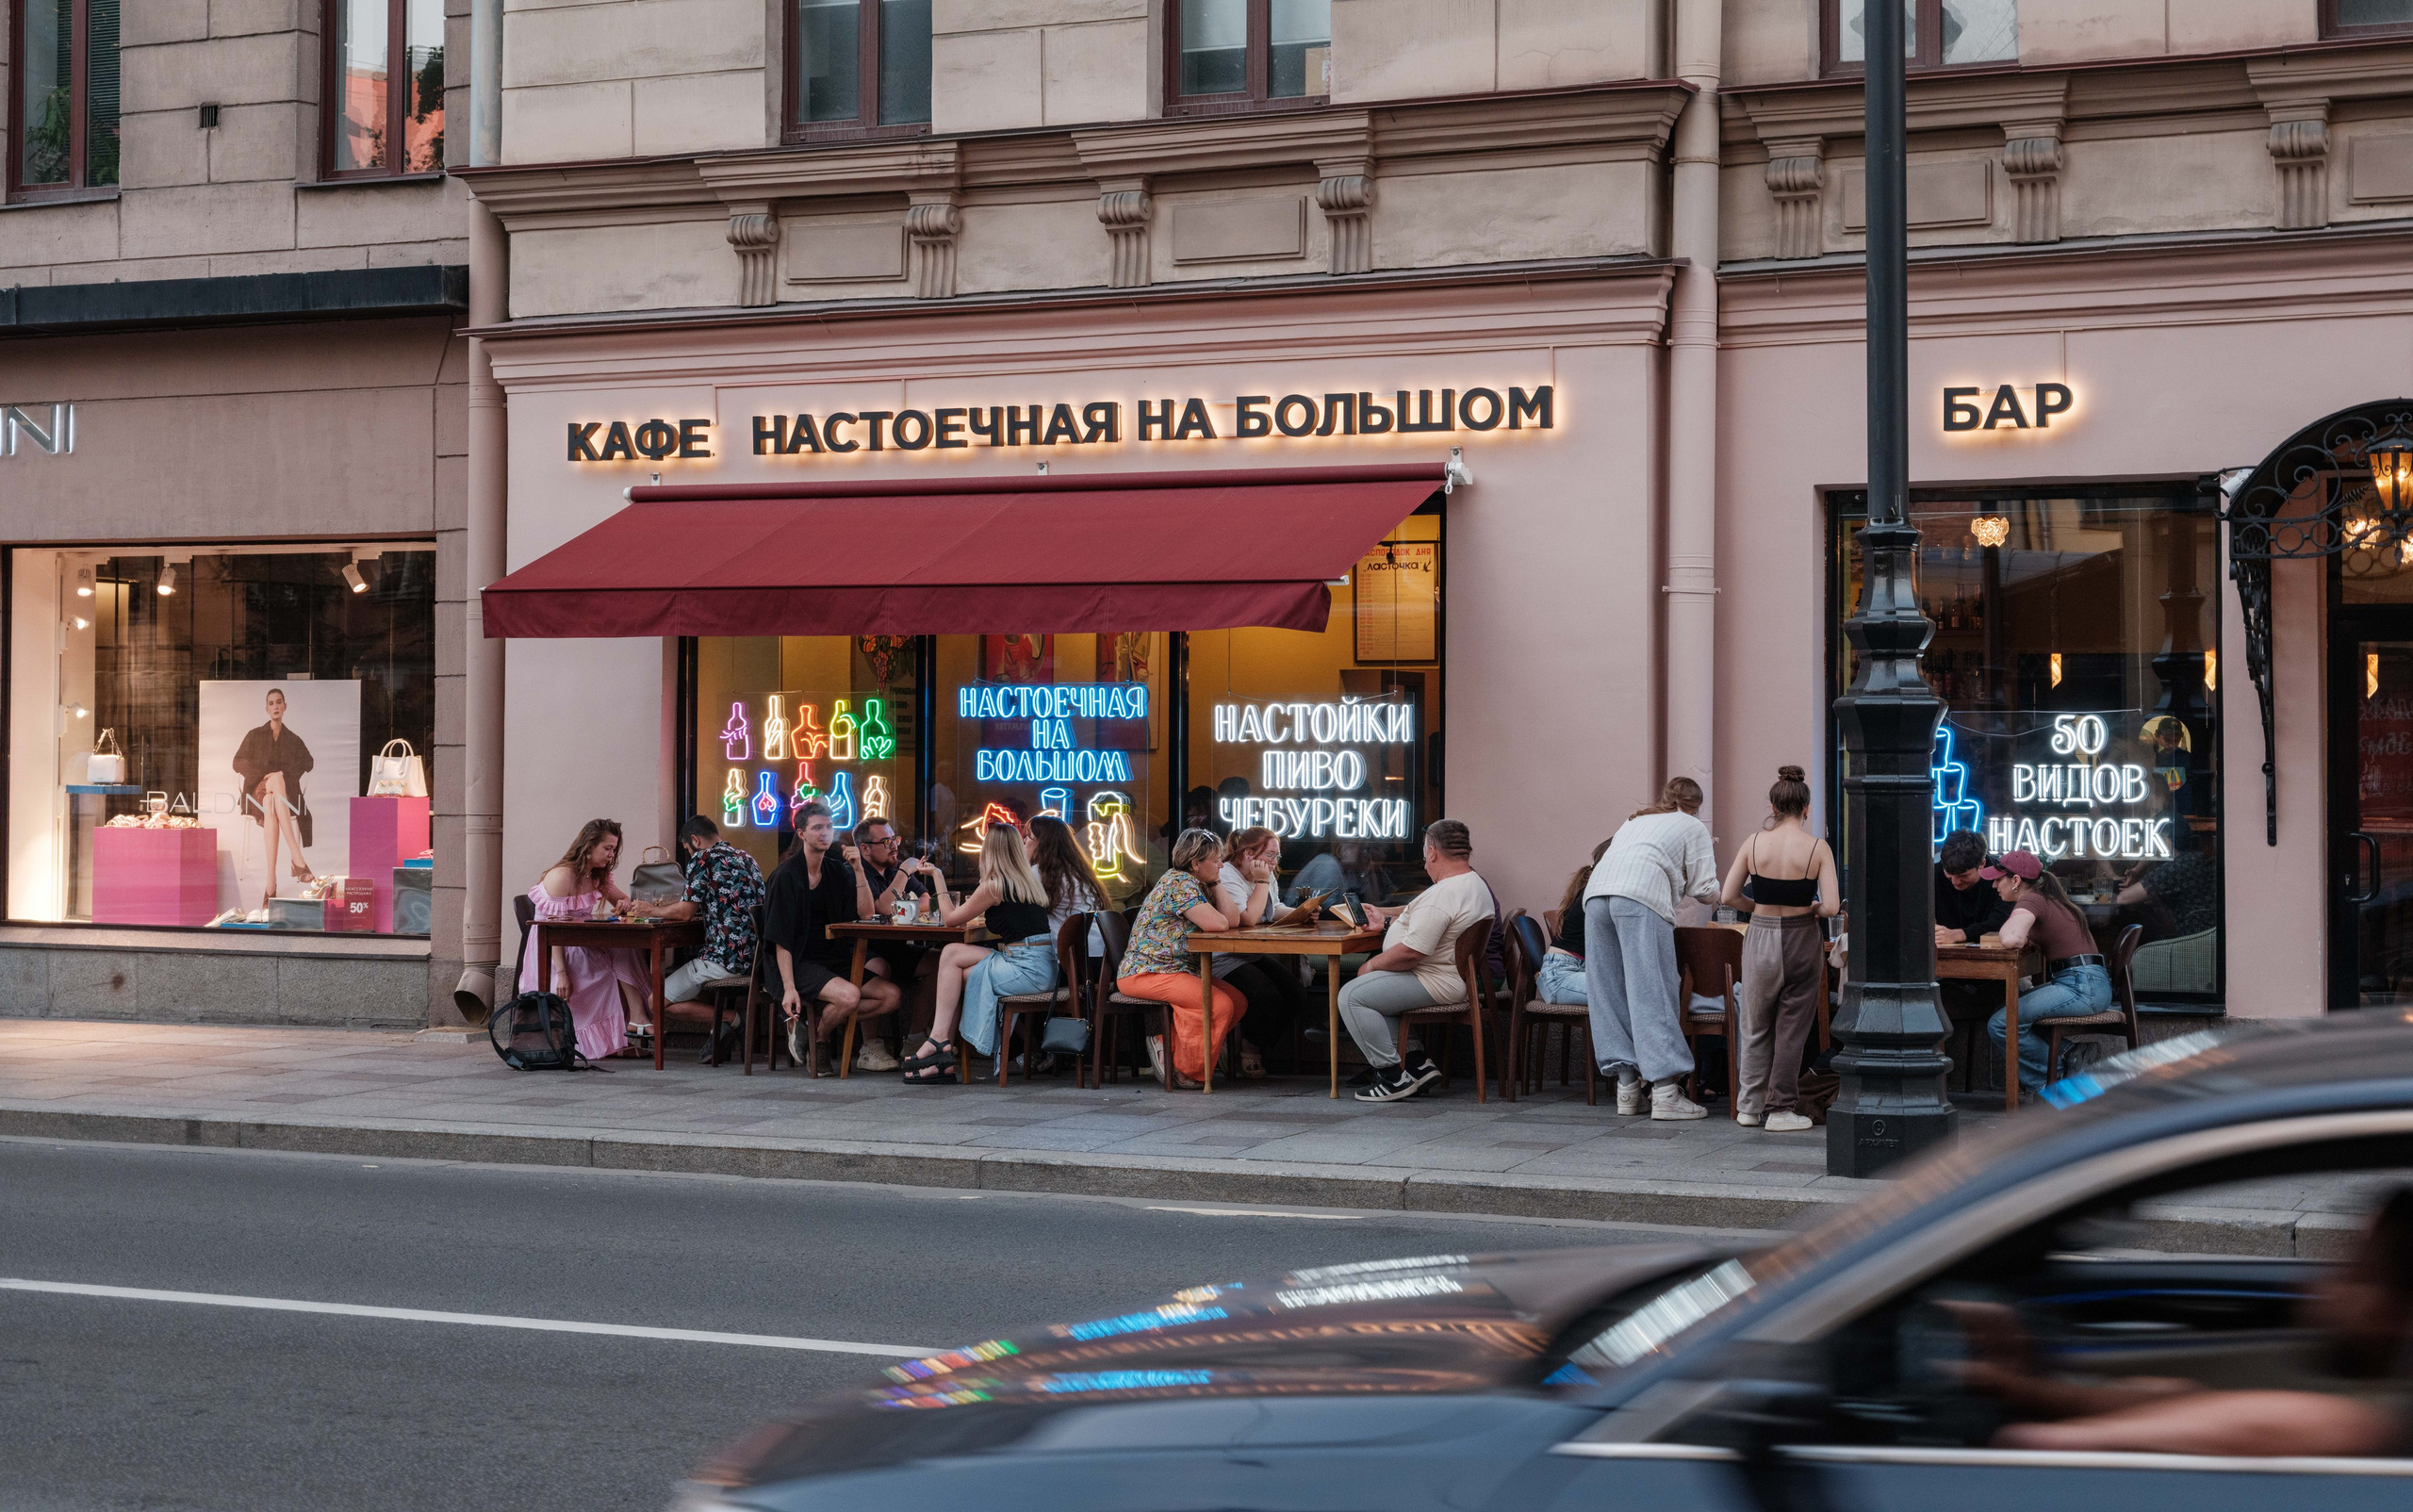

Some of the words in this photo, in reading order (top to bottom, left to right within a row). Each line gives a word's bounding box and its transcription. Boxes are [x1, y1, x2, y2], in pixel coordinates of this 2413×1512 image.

[567, 419, 711, 462] КАФЕ
[752, 401, 1120, 456] НАСТОЕЧНАЯ
[1138, 397, 1218, 441] НА
[1236, 386, 1553, 438] БОЛЬШОМ
[1944, 383, 2074, 431] БАР
[0, 403, 74, 456] NI
[960, 686, 1148, 719] НАСТОЕЧНАЯ
[1214, 696, 1414, 744] НАСТОЙКИ
[1032, 719, 1075, 748] НА
[2051, 714, 2108, 755] 50
[977, 750, 1133, 781] БОЛЬШОМ
[1262, 750, 1366, 790] ПИВО
[2012, 764, 2149, 808] ВИДОВ
[1219, 797, 1411, 840] ЧЕБУРЕКИ
[1989, 816, 2170, 857] НАСТОЕК
[350, 901, 369, 913] 50%
